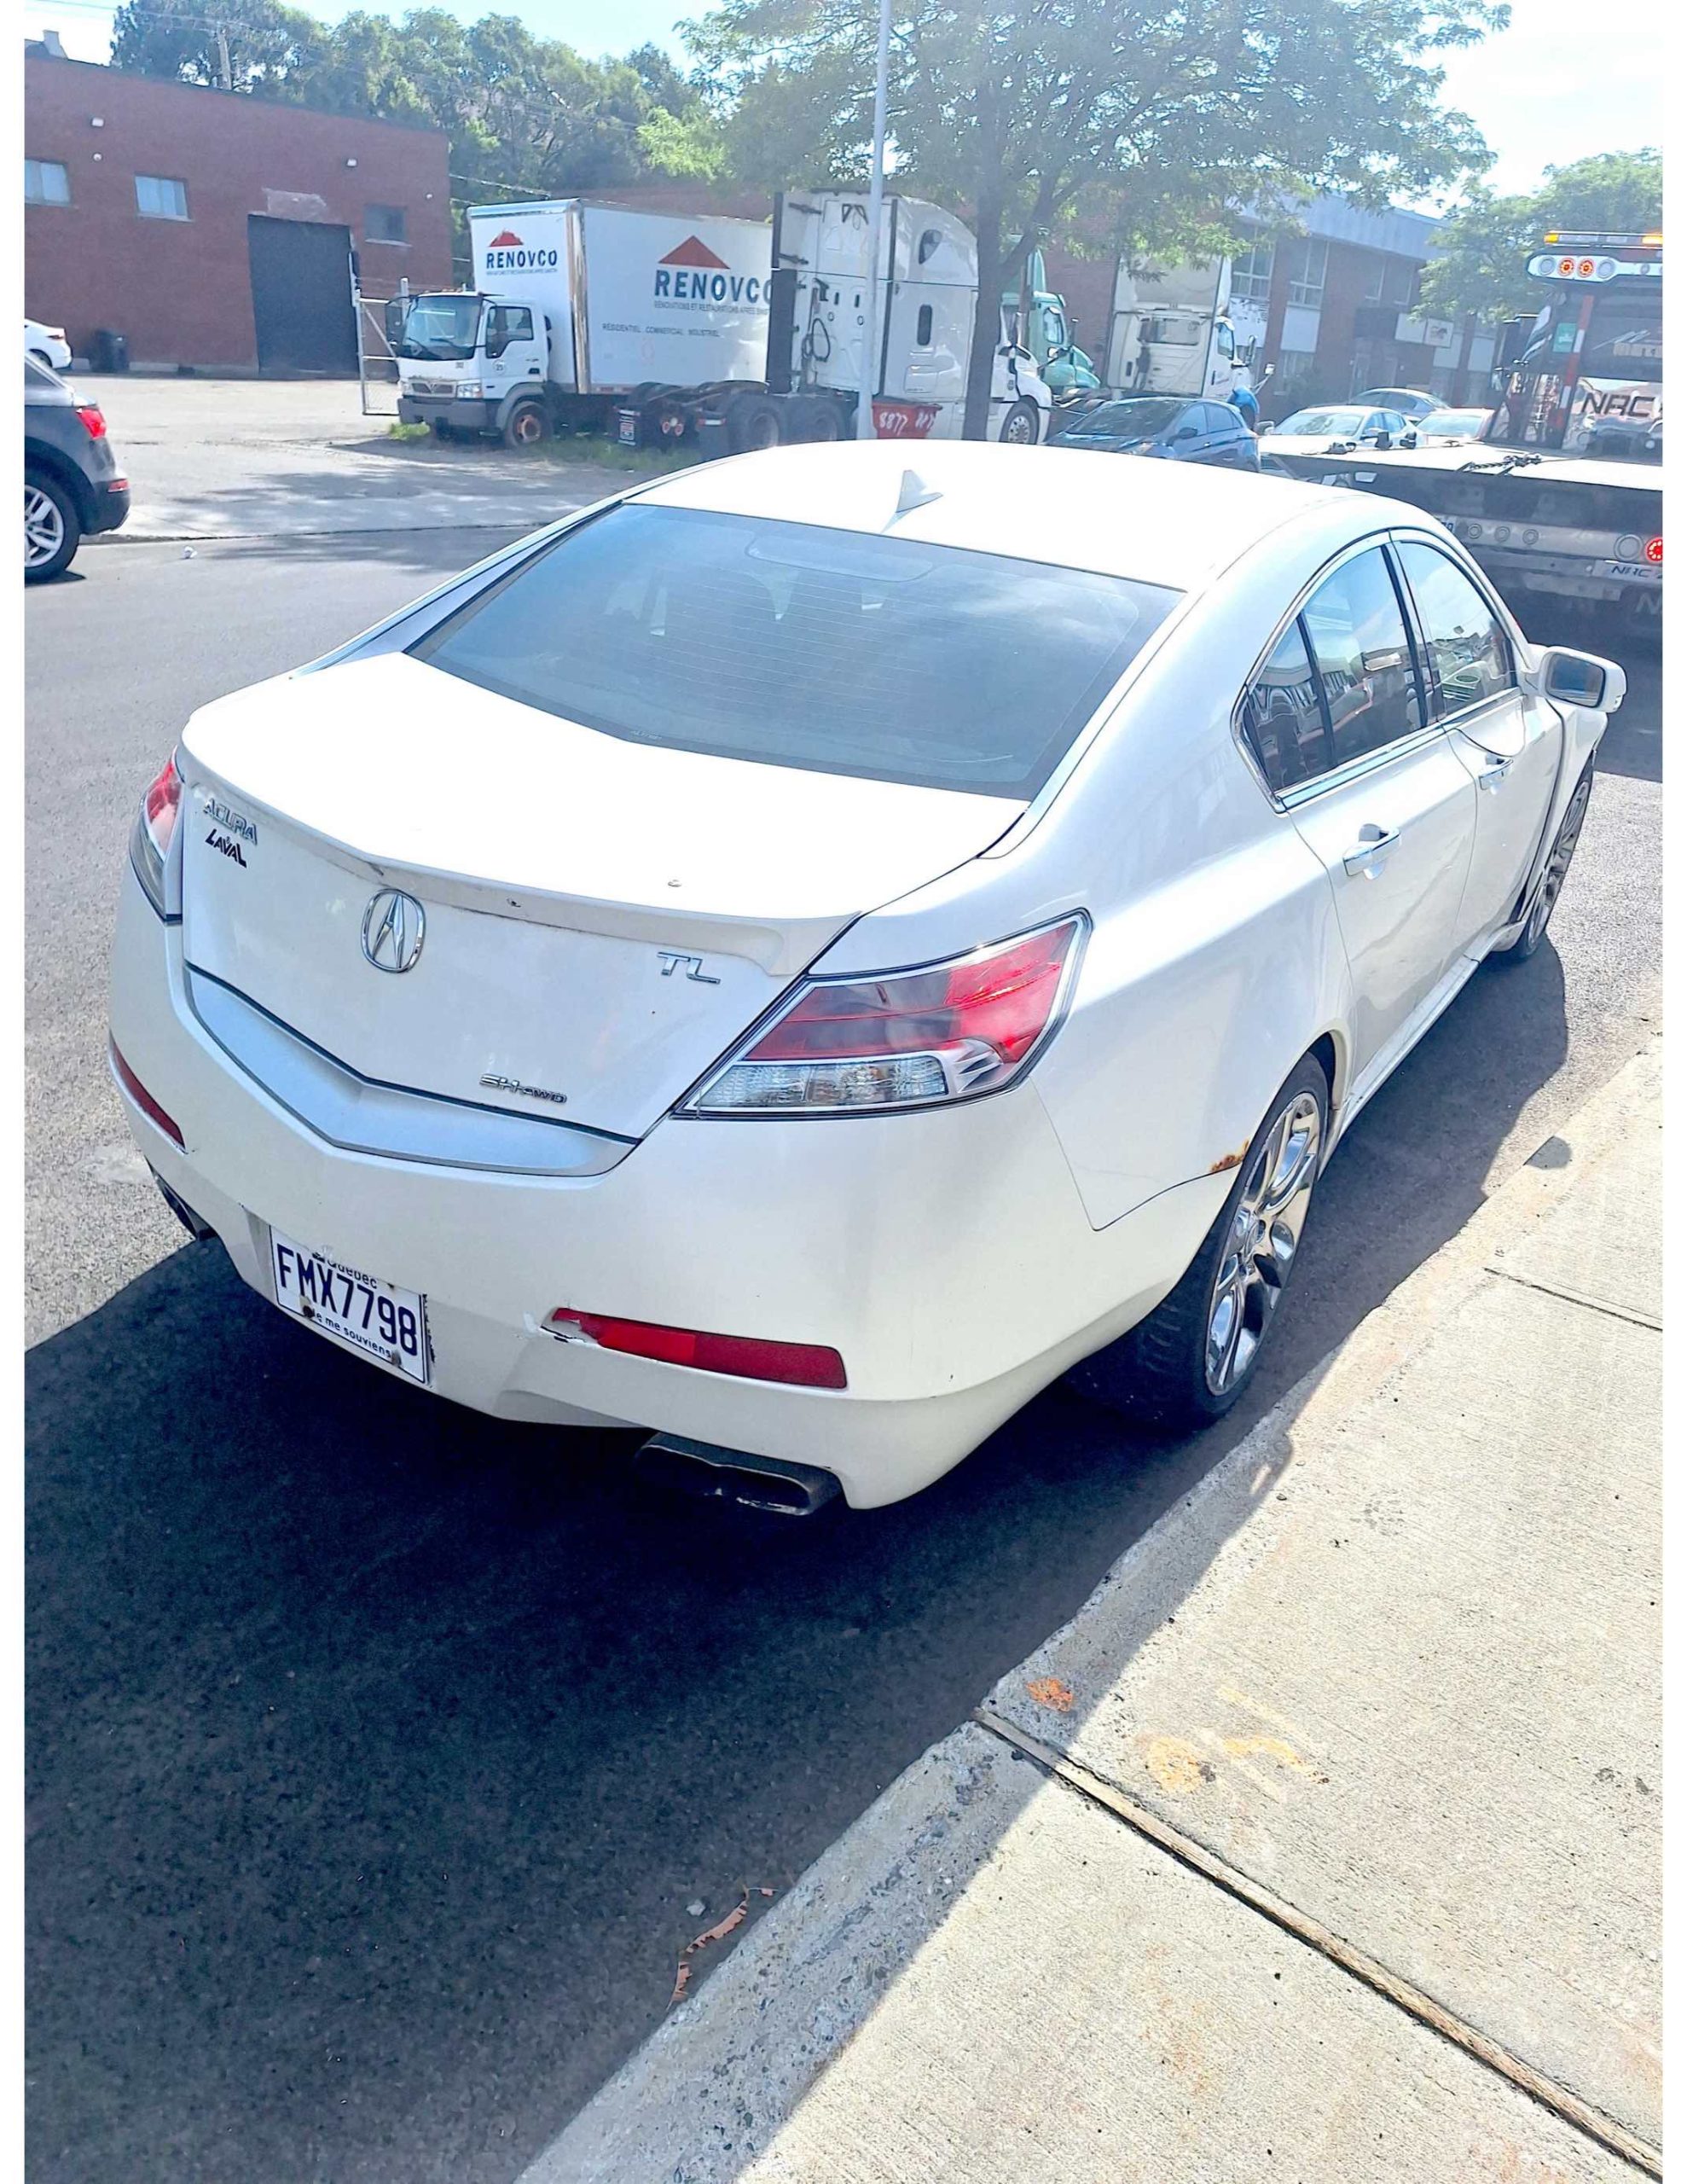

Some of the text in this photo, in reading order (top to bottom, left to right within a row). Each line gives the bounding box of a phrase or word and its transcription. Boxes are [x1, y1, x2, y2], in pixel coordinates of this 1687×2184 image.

[485, 249, 558, 269] RENOVCO
[1581, 392, 1656, 418] NRC
[203, 798, 258, 846] ACURA
[205, 828, 247, 868] LAVAL
[656, 951, 721, 985] TL
[276, 1243, 418, 1356] FMX7798
[325, 1317, 341, 1331] me
[343, 1327, 391, 1358] souviens
